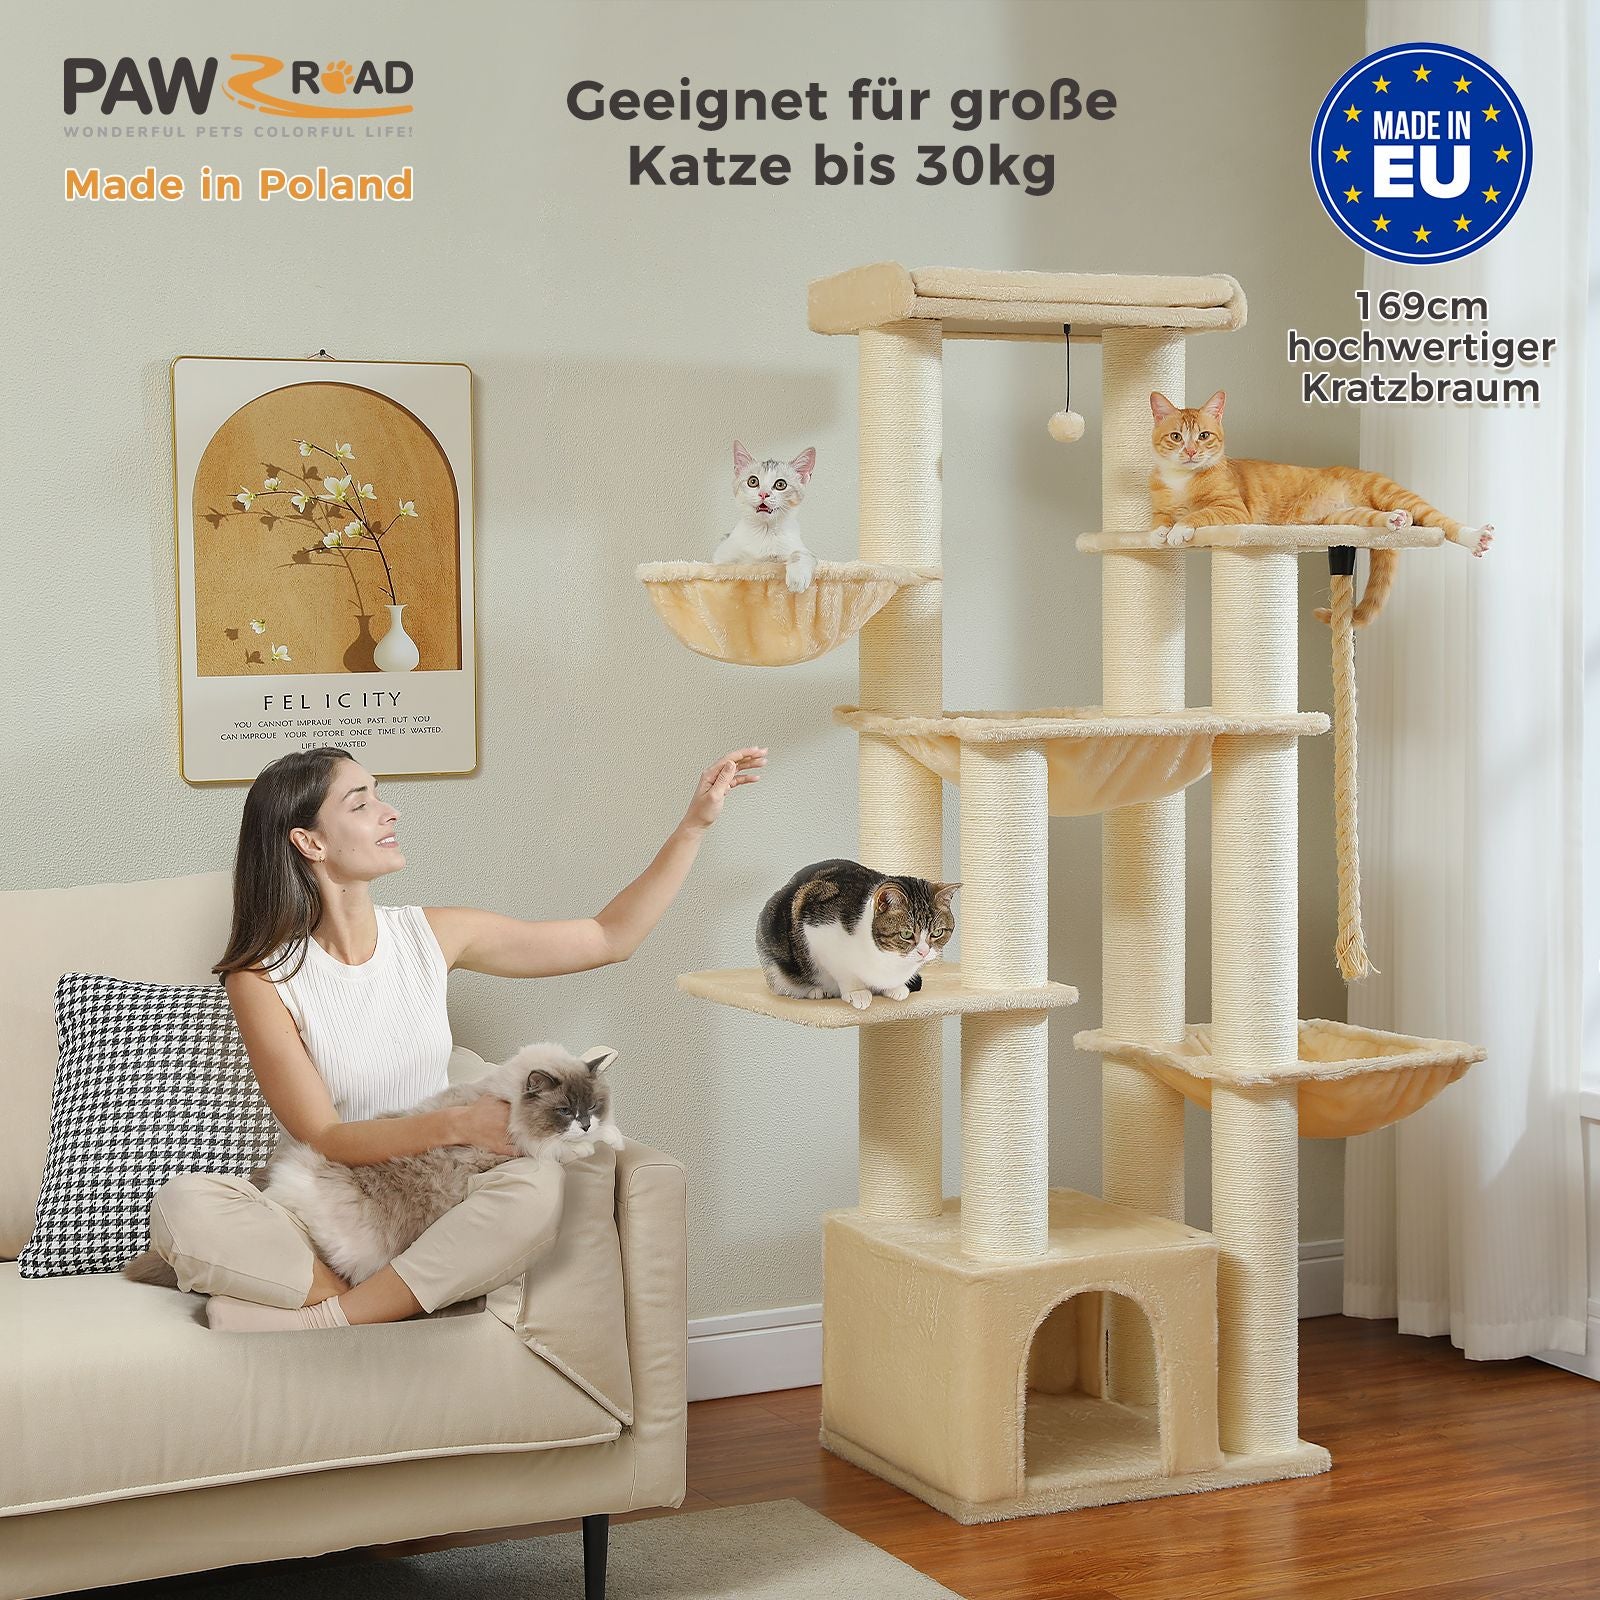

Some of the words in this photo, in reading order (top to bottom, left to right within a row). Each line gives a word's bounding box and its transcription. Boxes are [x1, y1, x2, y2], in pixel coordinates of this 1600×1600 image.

[234, 721, 252, 729] YOU
[258, 720, 293, 728] CANNOT
[339, 717, 361, 725] YOUR
[413, 715, 430, 723] YOU
[220, 733, 238, 741] CAN
[284, 730, 307, 739] YOUR
[349, 728, 373, 737] ONCE
[377, 727, 396, 736] TIME
[399, 727, 406, 735] IS
[301, 742, 317, 750] LIFE
[334, 740, 367, 748] WASTED
